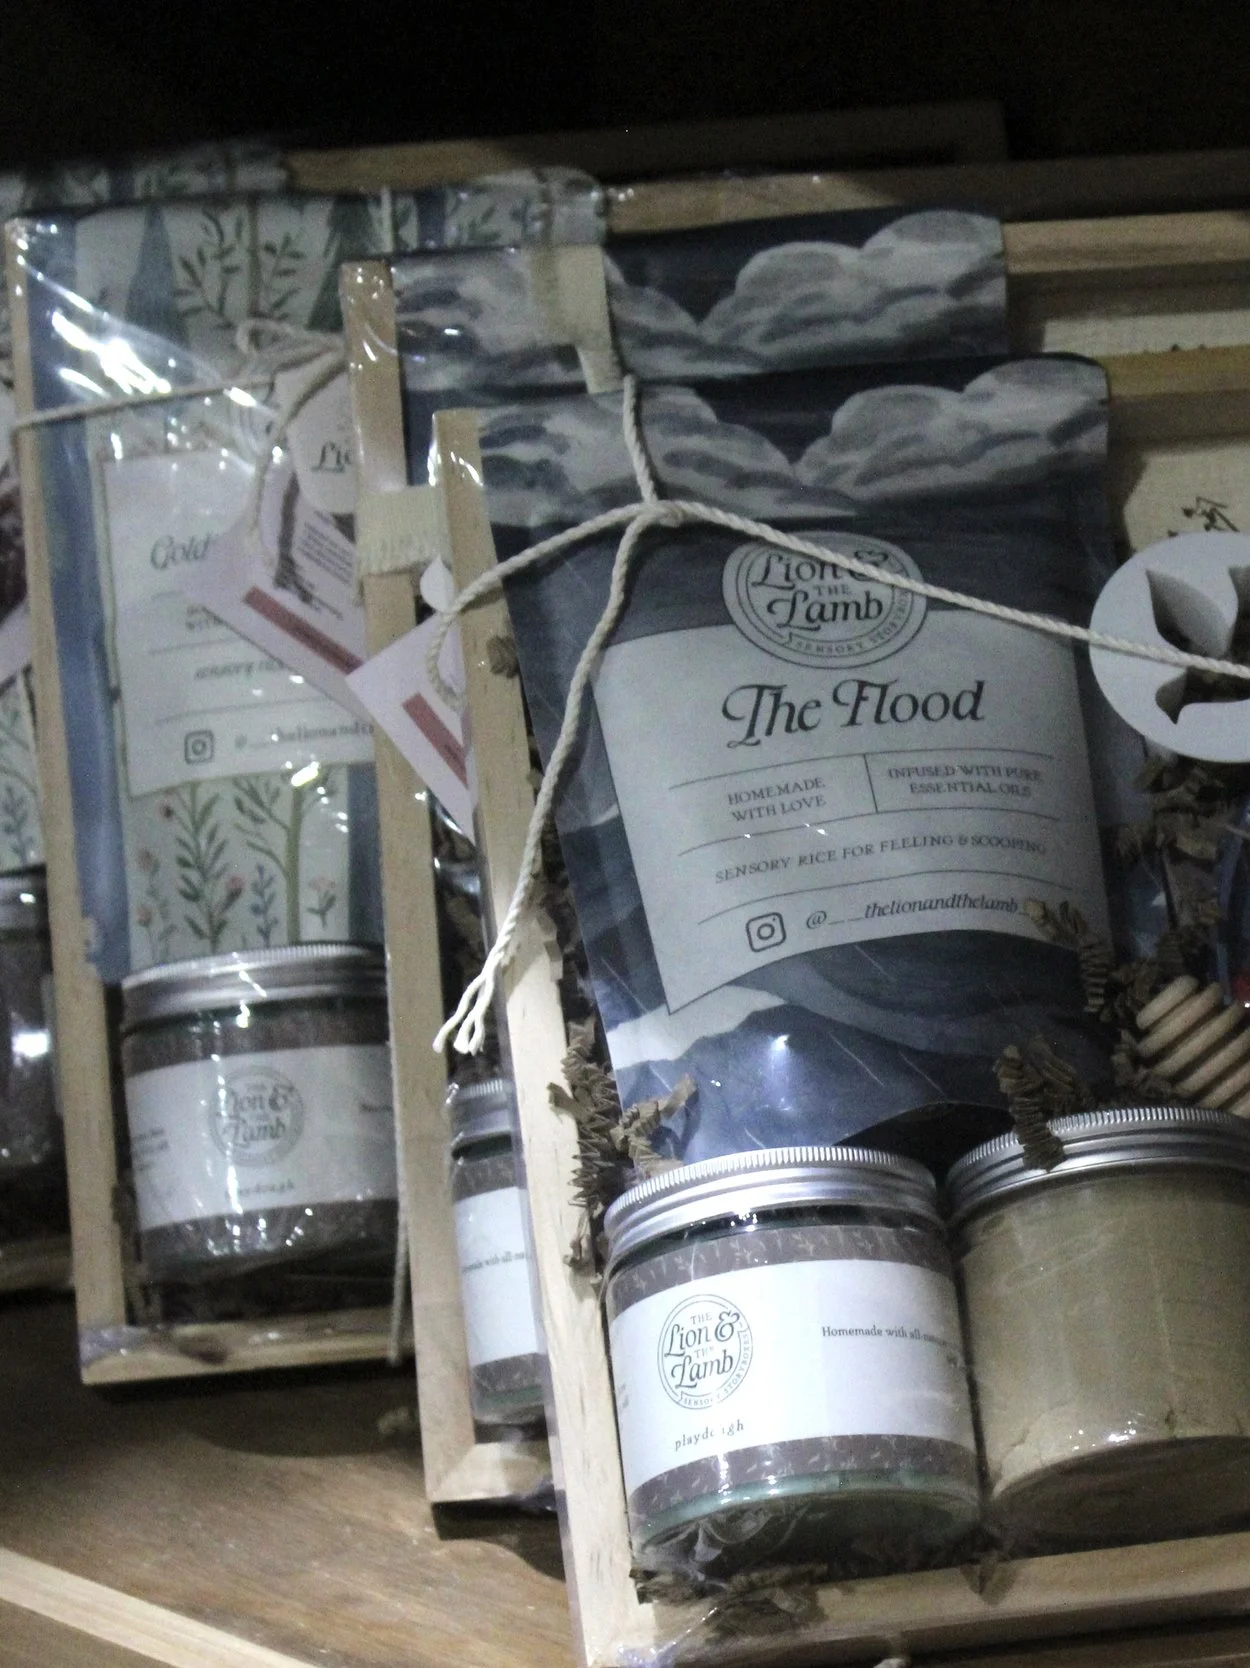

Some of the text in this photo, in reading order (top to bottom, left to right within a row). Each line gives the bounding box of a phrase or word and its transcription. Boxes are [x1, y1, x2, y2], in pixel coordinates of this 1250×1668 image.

[751, 553, 841, 590] Lion
[813, 584, 850, 596] THE
[767, 590, 883, 631] Lamb
[796, 640, 865, 655] SENSORY
[721, 678, 986, 748] The Flood
[888, 763, 1043, 782] INFUSED WITH PURE
[727, 776, 825, 805] HOMEMADE
[909, 781, 1031, 797] ESSENTIAL OILS
[730, 795, 827, 822] WITH LOVE
[714, 834, 1046, 884] SENSORY RICE FOR FEELING & SCOOPING
[690, 1312, 712, 1325] THE
[822, 1325, 883, 1337] Homemade
[885, 1326, 908, 1338] with
[664, 1310, 740, 1357] Lion &
[671, 1349, 734, 1389] Lamb
[683, 1392, 721, 1406] SENSOY
